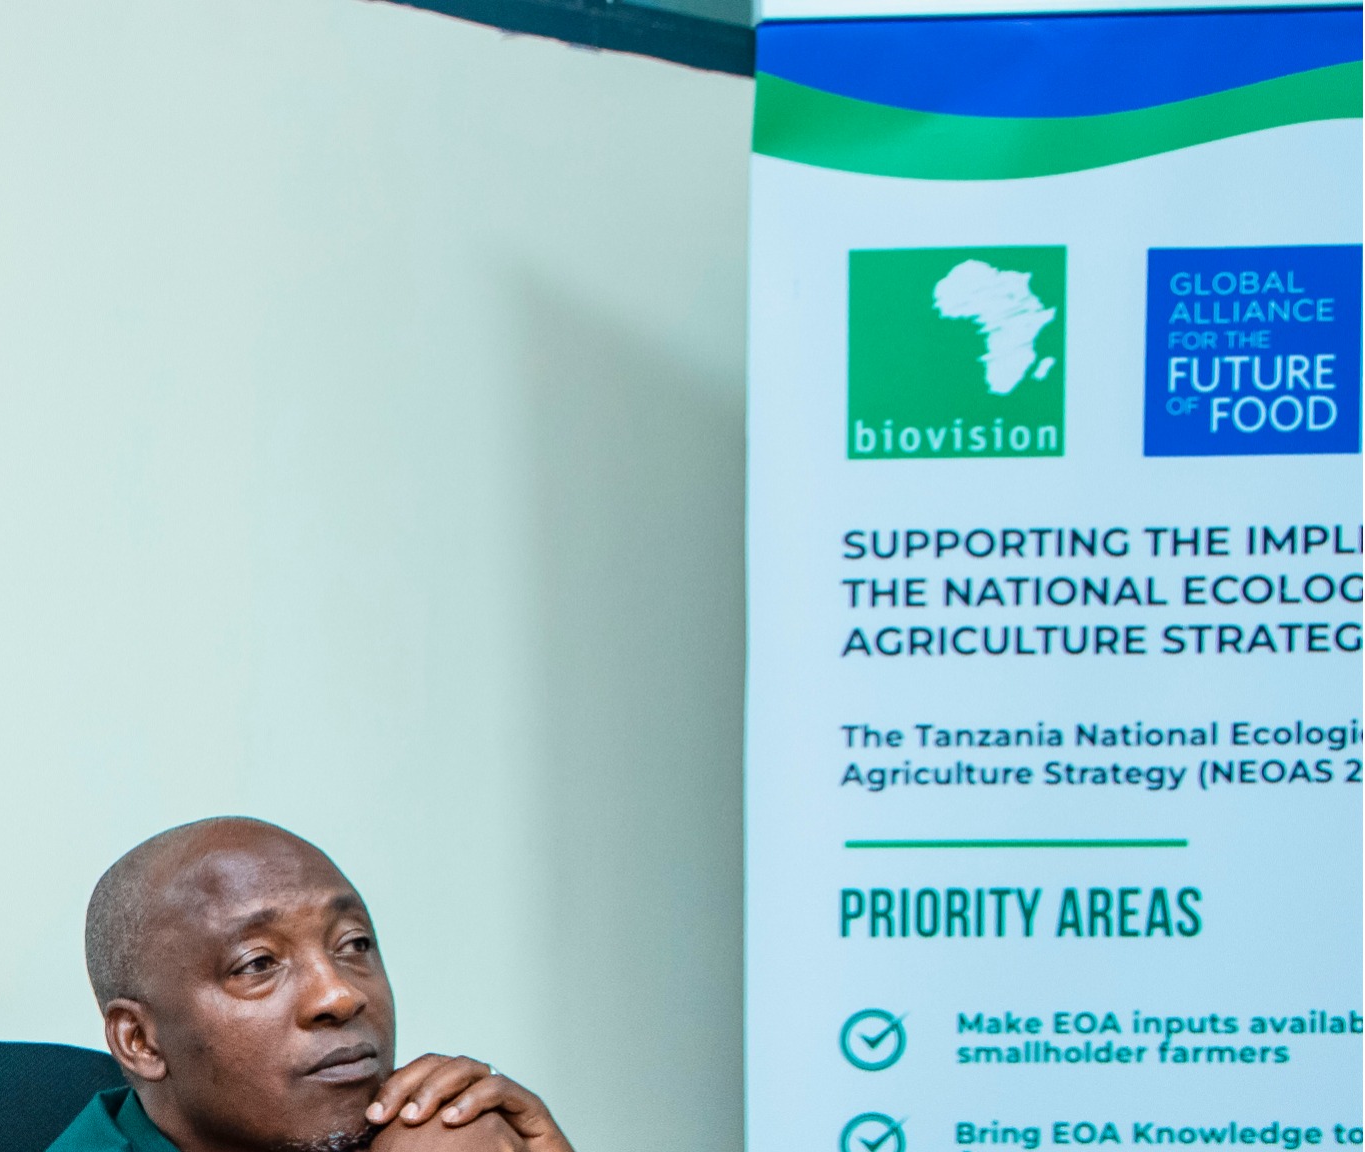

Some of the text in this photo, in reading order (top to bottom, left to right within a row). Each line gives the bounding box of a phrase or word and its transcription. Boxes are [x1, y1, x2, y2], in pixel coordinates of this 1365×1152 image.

[1169, 270, 1305, 297] GLOBAL
[1168, 297, 1335, 325] ALLIANCE
[1167, 329, 1271, 351] FOR THE
[1169, 354, 1335, 392] FUTURE
[1165, 395, 1338, 432] OF FOOD
[854, 418, 1058, 453] biovision
[843, 523, 1363, 560] SUPPORTING THE IMPL
[841, 571, 1363, 608] THE NATIONAL ECOLOG
[842, 621, 1363, 657] AGRICULTURE STRATEG
[841, 718, 1363, 752] The Tanzania National Ecologi
[840, 760, 1035, 793] Agriculture
[1044, 760, 1188, 791] Strategy
[1199, 758, 1335, 791] (NEOAS
[839, 885, 1203, 939] PRIORITY AREAS
[957, 1008, 1363, 1043] Make EOA inputs availab
[956, 1039, 1291, 1065] smallholder farmers
[955, 1119, 1363, 1151] Bring EOA Knowledge to
